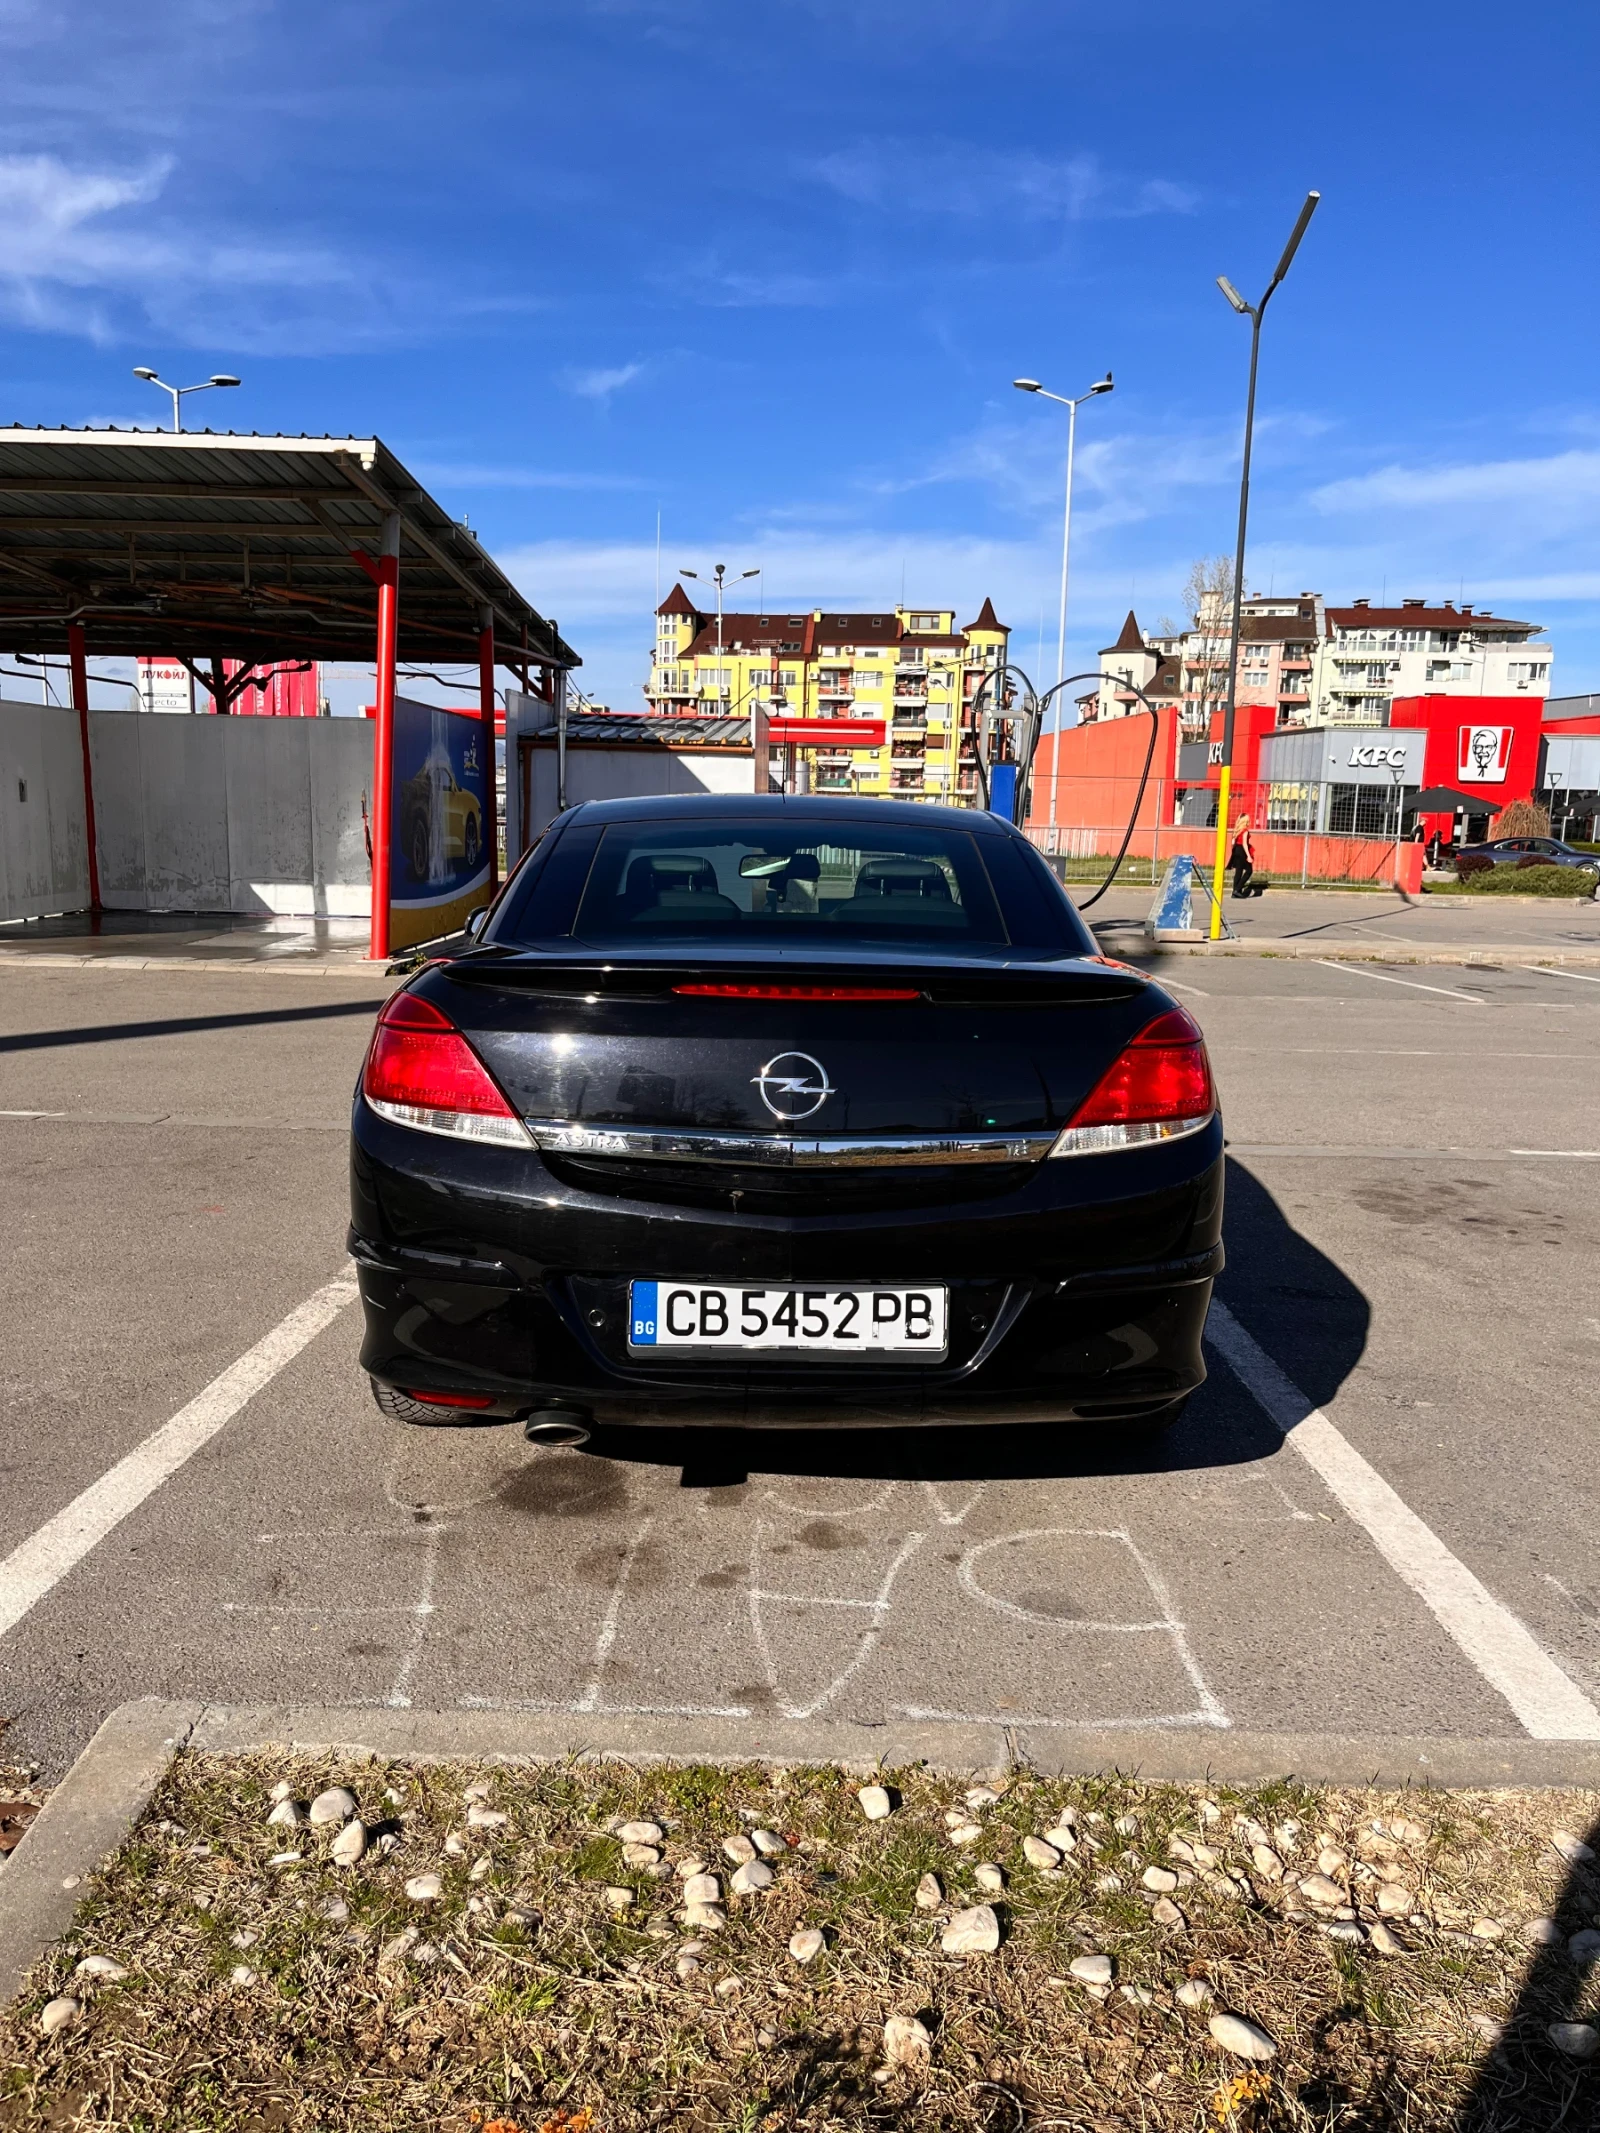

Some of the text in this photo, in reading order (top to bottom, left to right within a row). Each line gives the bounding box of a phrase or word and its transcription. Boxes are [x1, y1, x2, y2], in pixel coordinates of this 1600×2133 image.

[1348, 746, 1407, 768] KFC
[554, 1132, 629, 1151] ASTRA
[740, 1289, 861, 1339] 5452
[634, 1320, 655, 1335] BG
